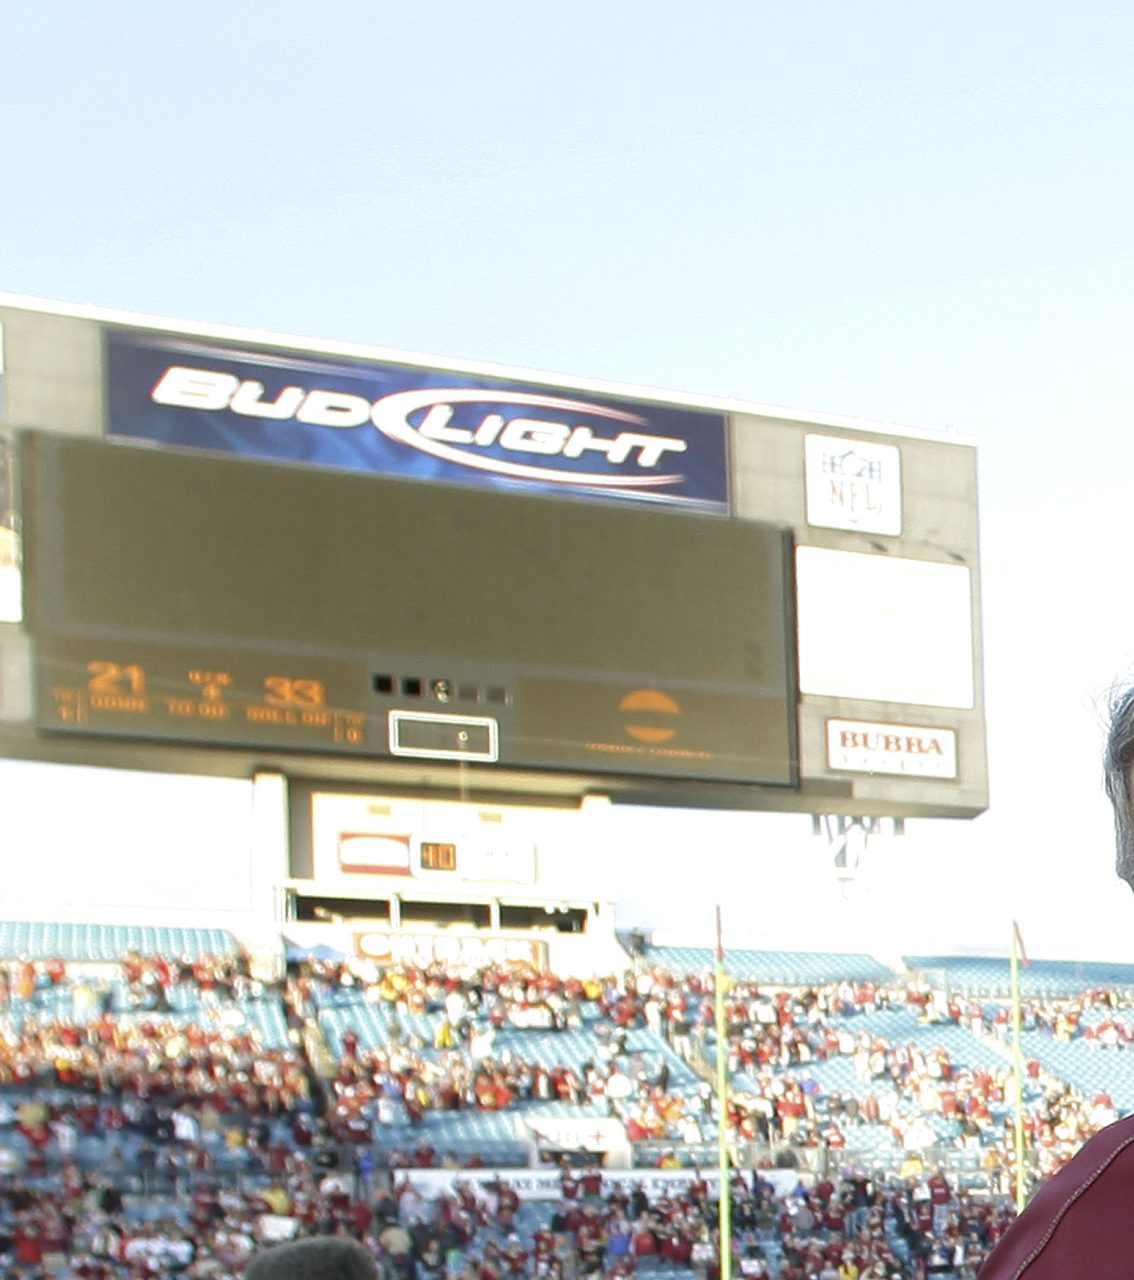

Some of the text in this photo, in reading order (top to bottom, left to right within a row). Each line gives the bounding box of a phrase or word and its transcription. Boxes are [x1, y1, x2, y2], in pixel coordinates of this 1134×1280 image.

[151, 366, 687, 468] BUD LIGHT
[87, 661, 145, 696] 21
[264, 676, 324, 706] 33
[839, 730, 944, 756] BUBBA
